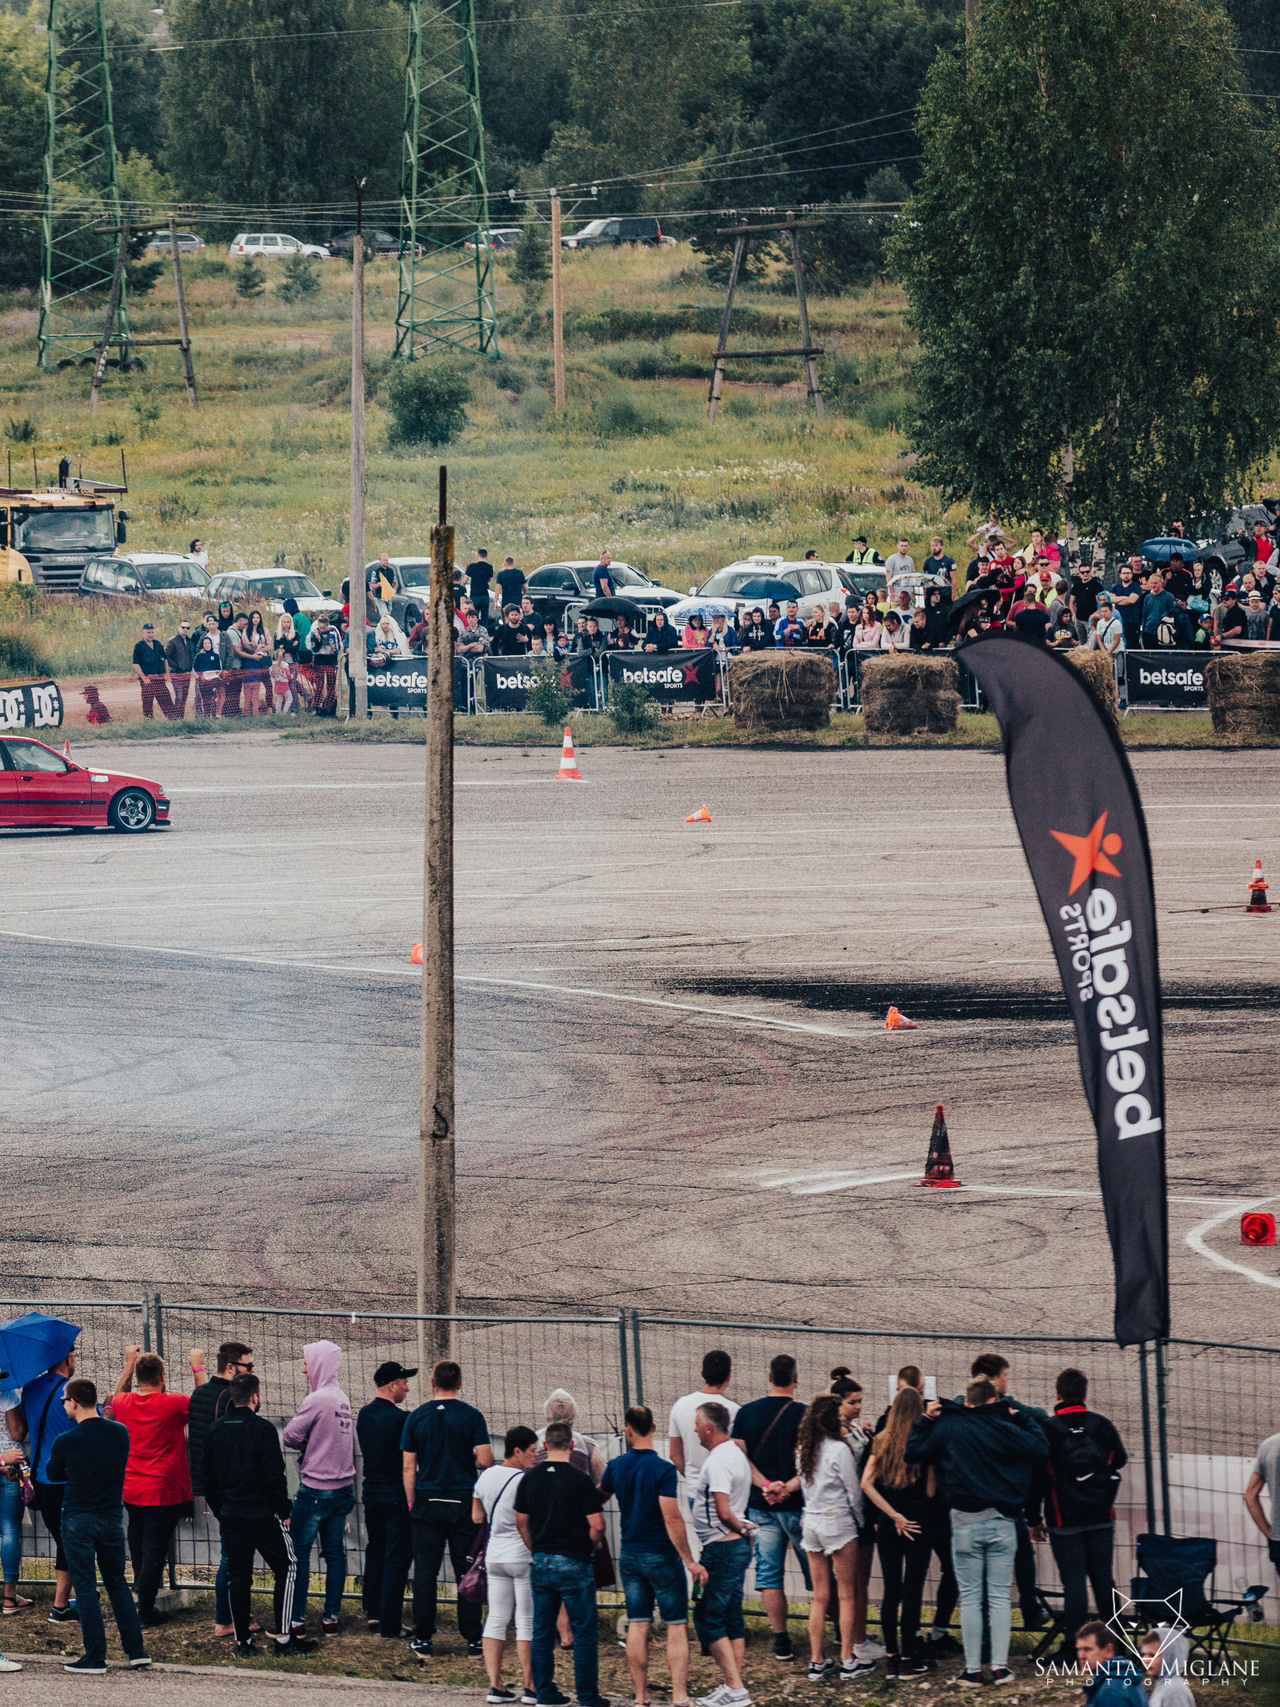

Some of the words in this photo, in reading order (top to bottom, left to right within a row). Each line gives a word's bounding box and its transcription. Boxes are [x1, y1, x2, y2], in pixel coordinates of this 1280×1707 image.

[496, 672, 549, 690] betsa
[623, 667, 683, 684] betsafe
[1139, 668, 1204, 686] betsafe
[31, 685, 61, 726] DC
